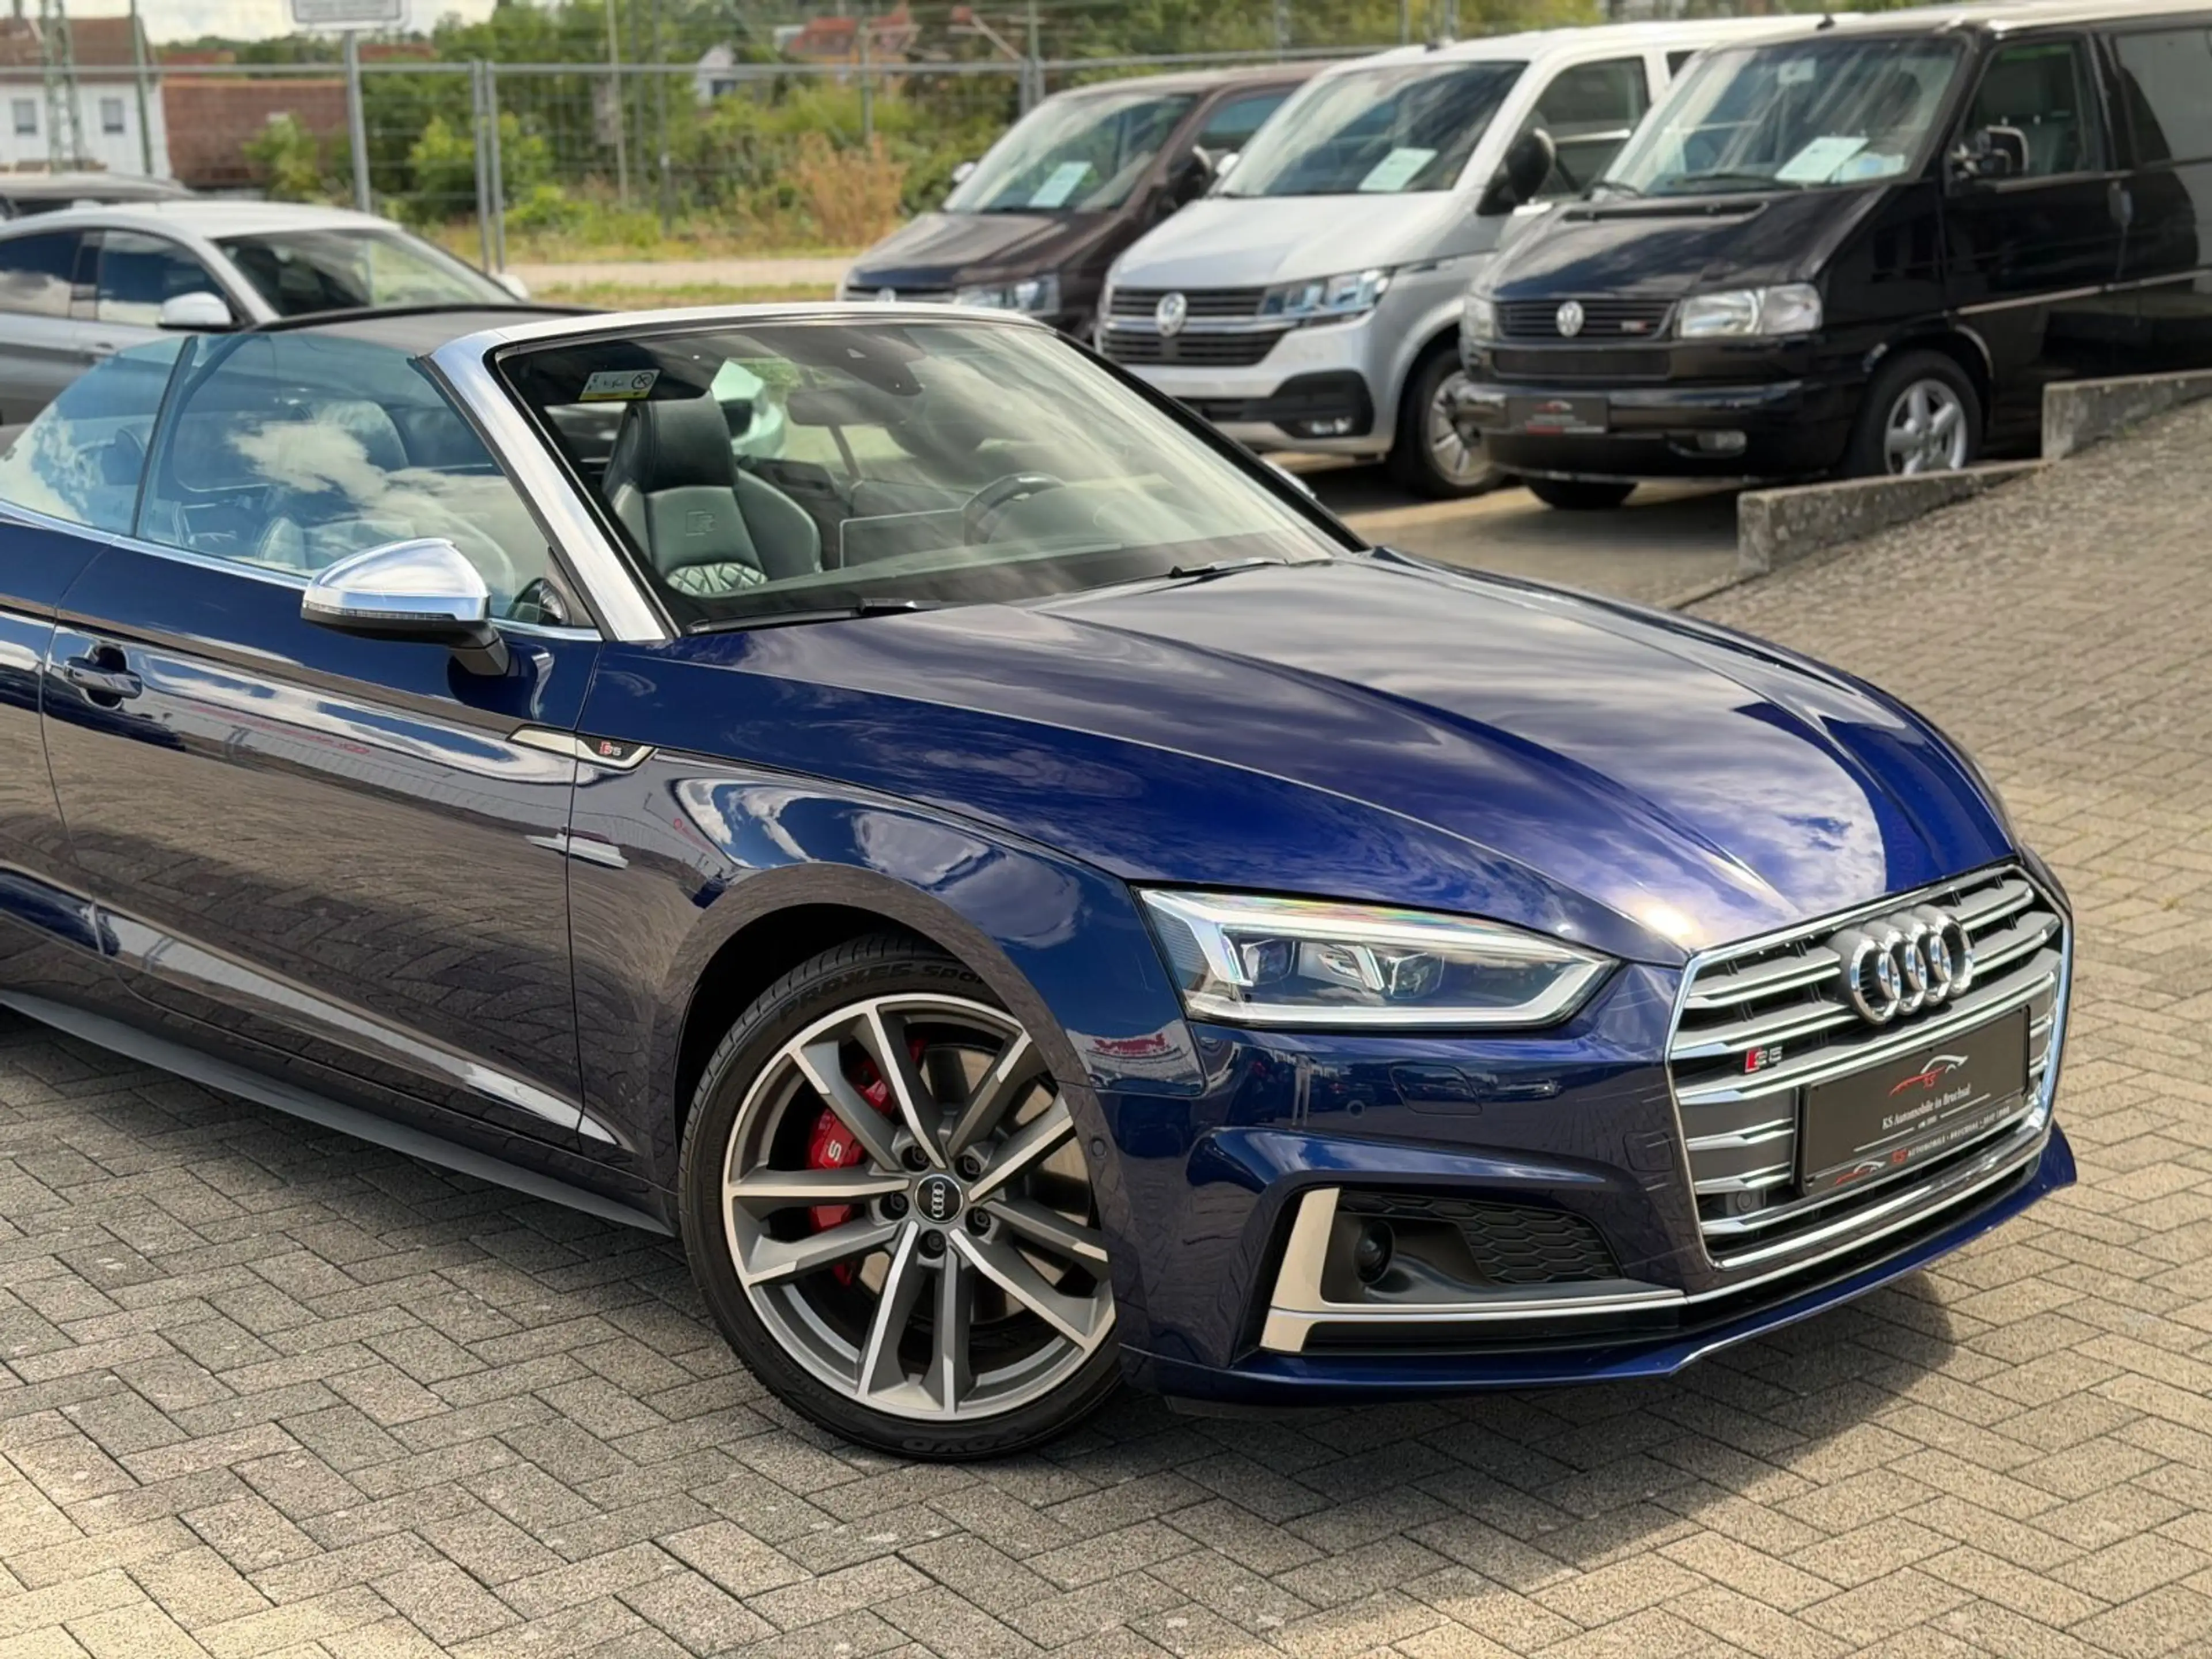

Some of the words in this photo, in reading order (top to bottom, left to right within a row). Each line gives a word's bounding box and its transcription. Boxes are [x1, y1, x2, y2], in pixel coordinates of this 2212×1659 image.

[600, 741, 622, 756] S5
[1749, 1046, 1783, 1070] S5
[1882, 1114, 1893, 1130] KS
[828, 1139, 842, 1162] S
